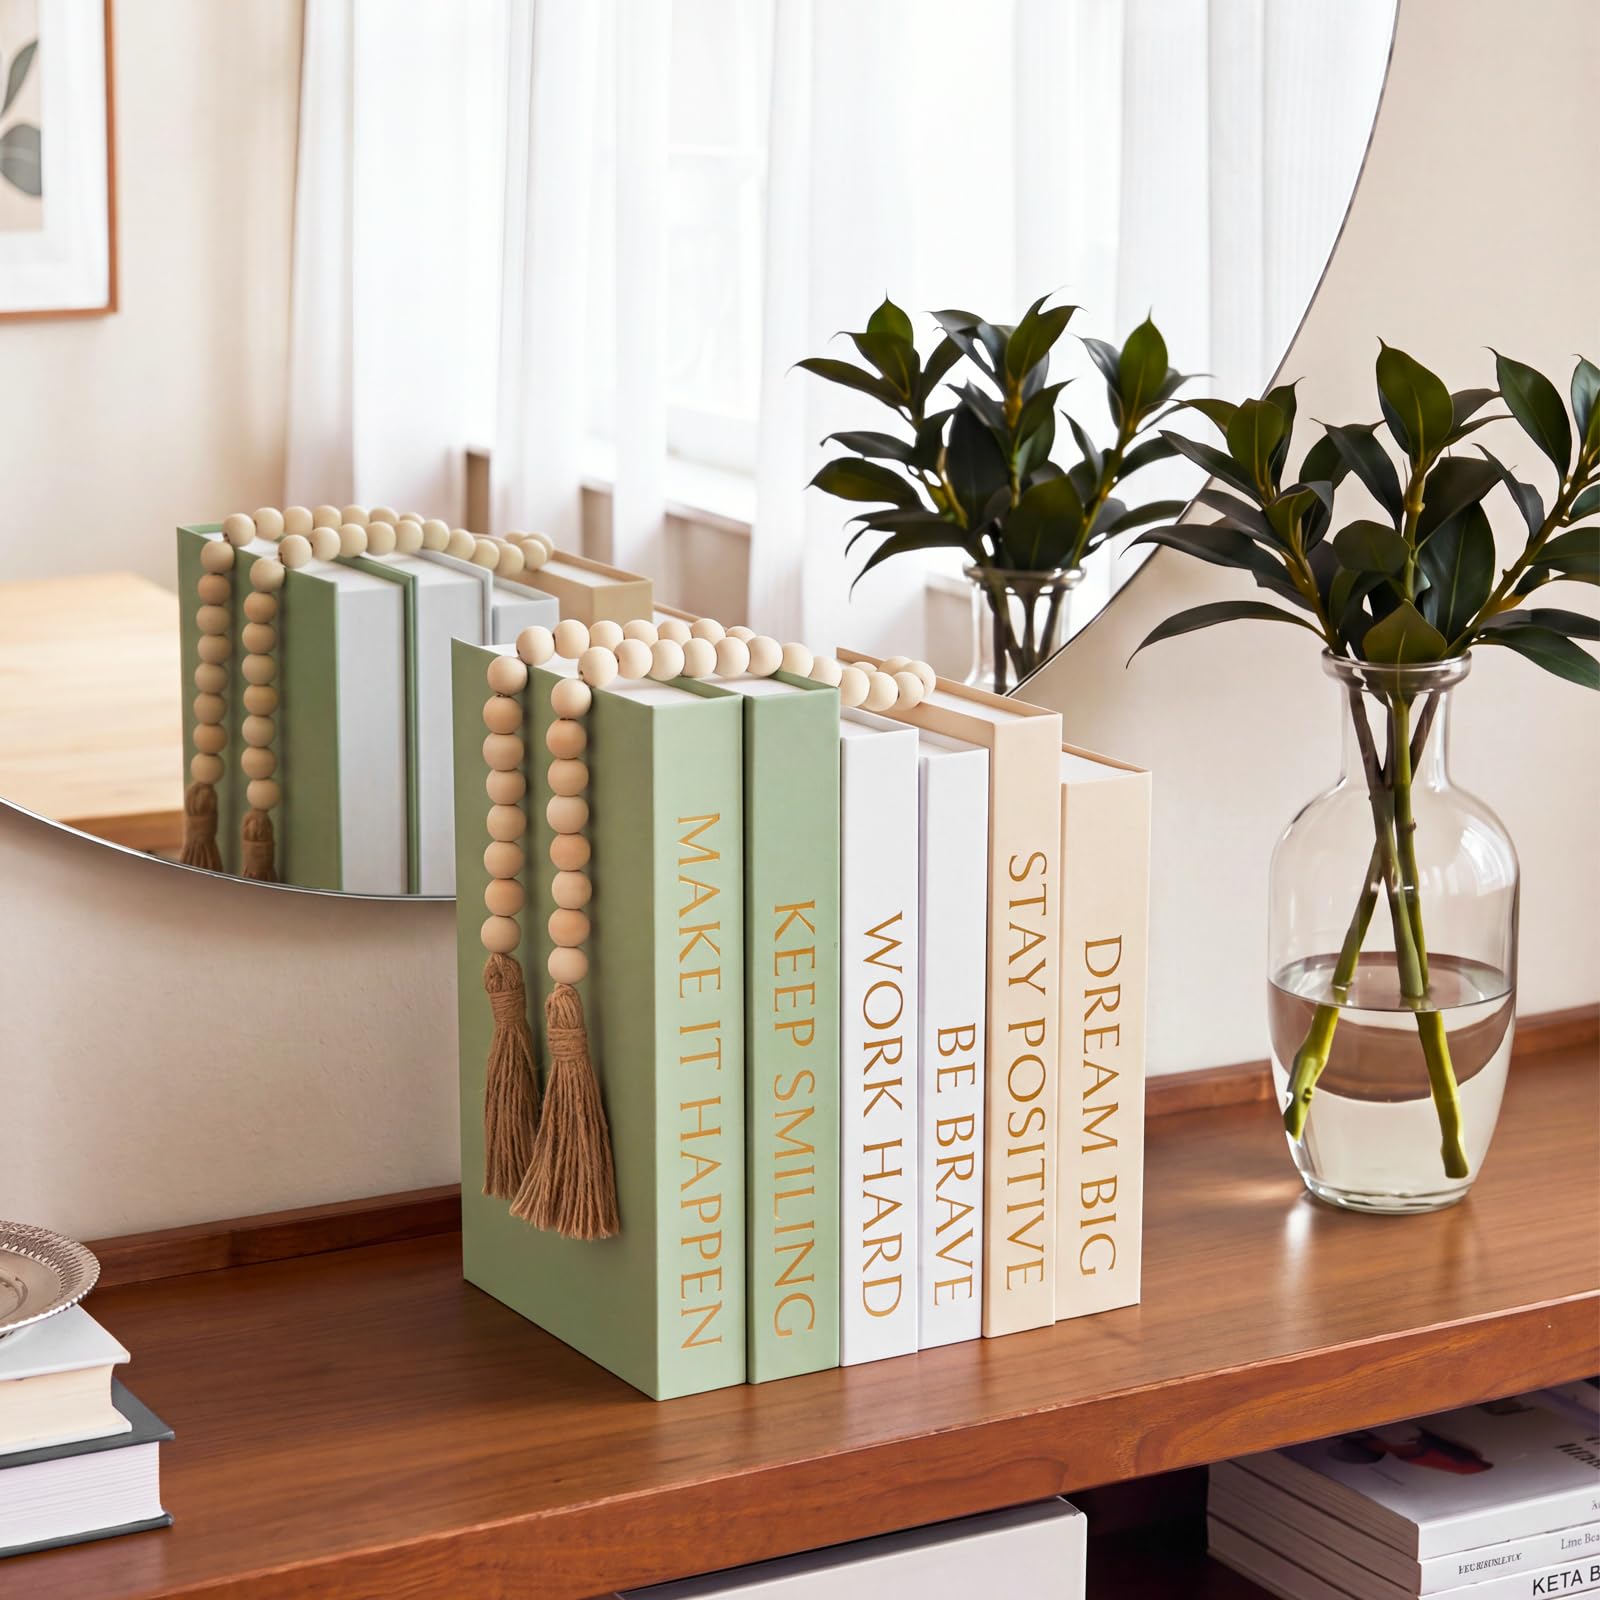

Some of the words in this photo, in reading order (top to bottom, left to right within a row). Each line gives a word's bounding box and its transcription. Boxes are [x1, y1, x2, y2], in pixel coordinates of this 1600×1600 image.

[676, 812, 722, 1000] MAKE
[772, 898, 816, 1048] KEEP
[1008, 851, 1048, 995] STAY
[676, 1017, 724, 1072] IT
[862, 912, 904, 1117] WORK
[935, 1023, 977, 1093] BE
[1080, 935, 1123, 1154] DREAM
[678, 1094, 724, 1349] HAPPEN
[772, 1068, 816, 1338] SMILING
[862, 1138, 904, 1318] HARD
[934, 1113, 976, 1306] BRAVE
[1006, 1017, 1047, 1291] POSITIVE
[1078, 1175, 1119, 1277] BIG
[1533, 1568, 1582, 1597] KETA
